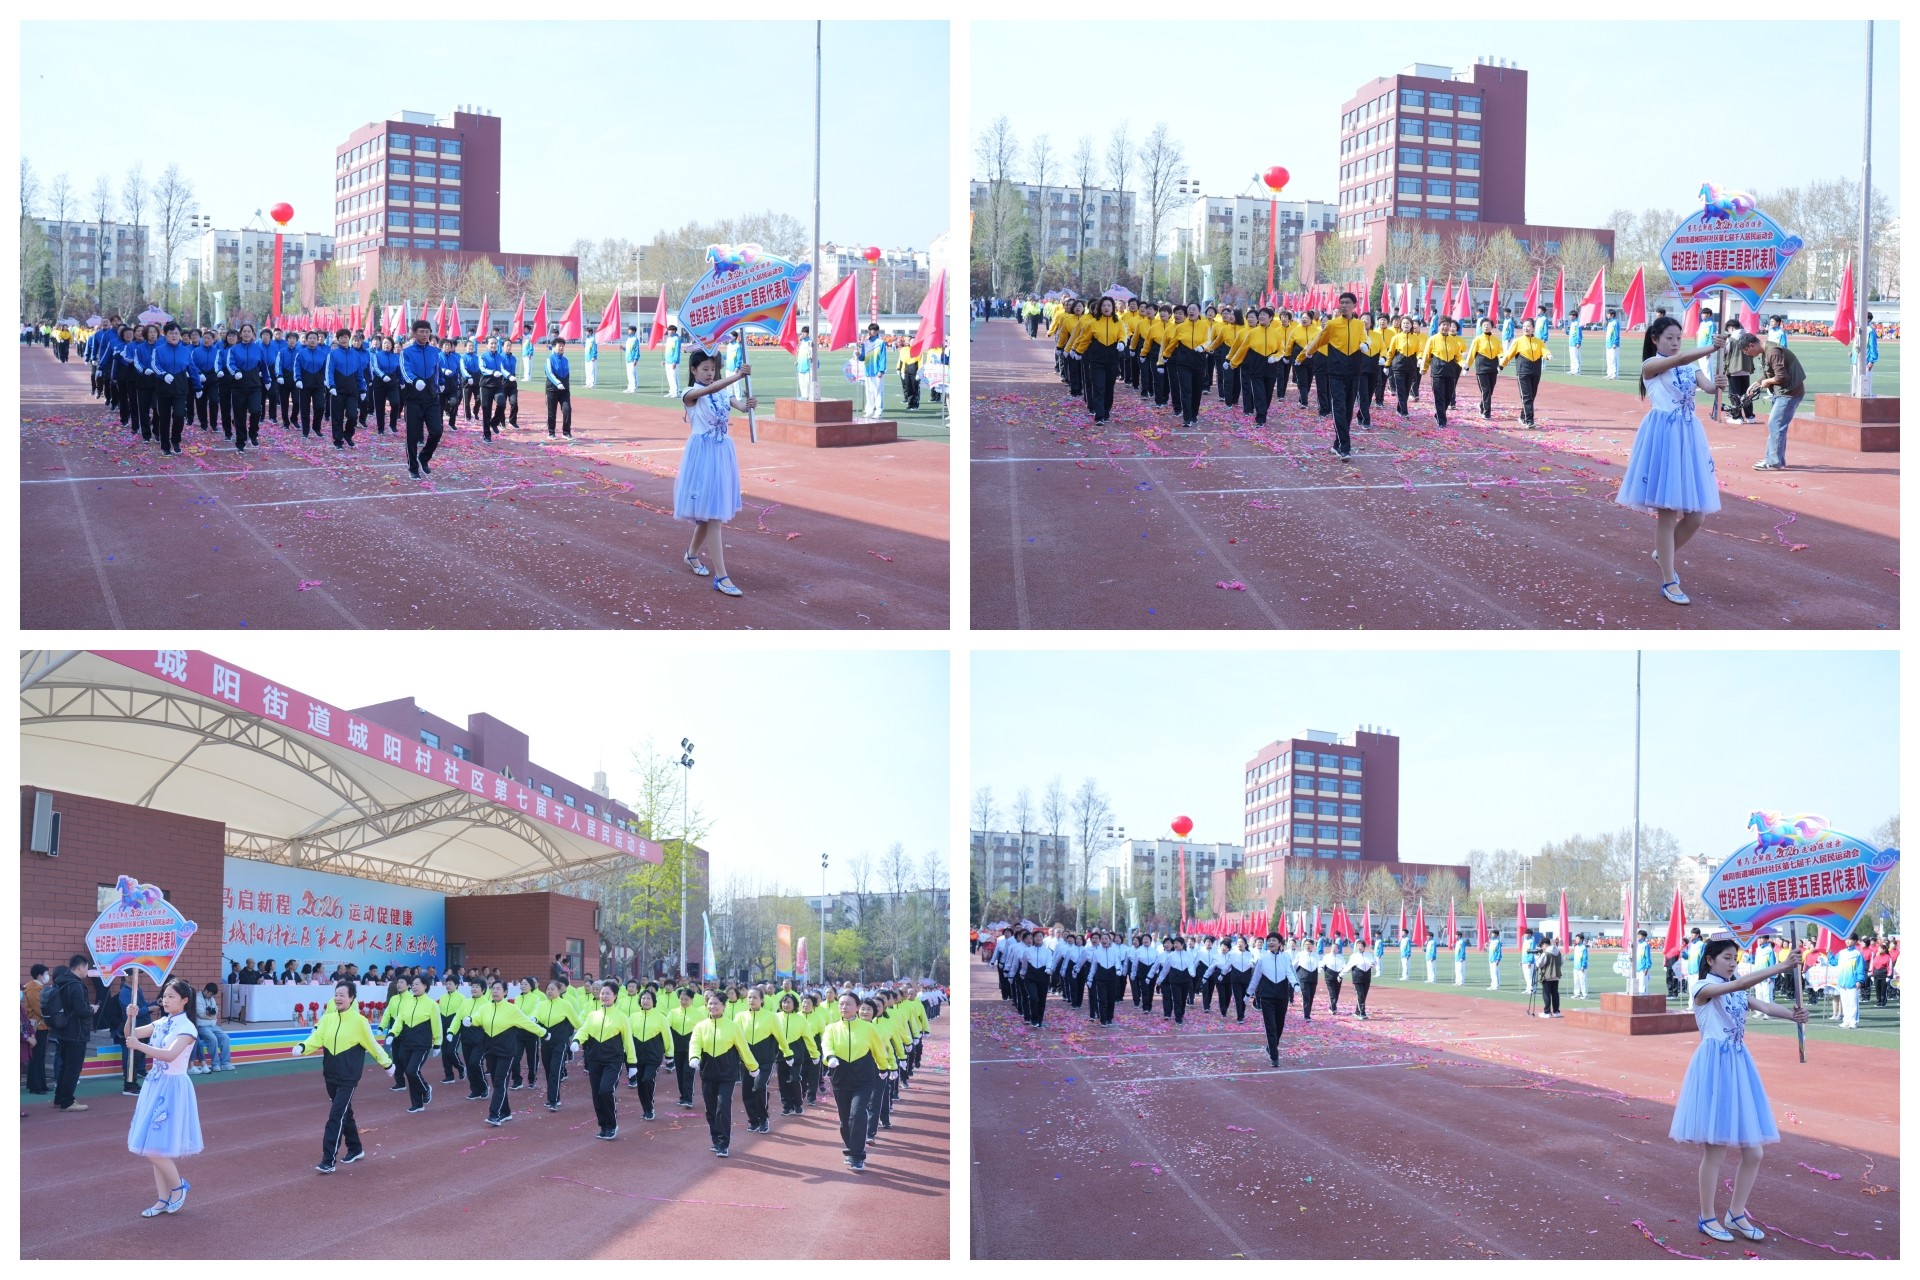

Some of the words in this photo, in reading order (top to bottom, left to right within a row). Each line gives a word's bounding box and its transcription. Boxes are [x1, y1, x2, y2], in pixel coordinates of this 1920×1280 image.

[1671, 247, 1777, 271] 世纪民生小高层第三居民代表队
[689, 279, 792, 327] 世纪民生小高层第二居民代表队
[155, 650, 647, 857] 城阳街道城阳村社区第七届千人居民运动会
[1722, 848, 1860, 881] 城阳街道城阳村社区第七届千人居民运动会
[1774, 845, 1800, 859] 2026
[1718, 864, 1870, 911] 世纪民生小高层第五居民代表队
[297, 888, 344, 919] 2026
[349, 903, 414, 927] 运动促健康
[95, 931, 177, 953] 世纪民生小高层第四居民代表队
[222, 917, 438, 957] 城阳村社区第七届千人居民运动会
